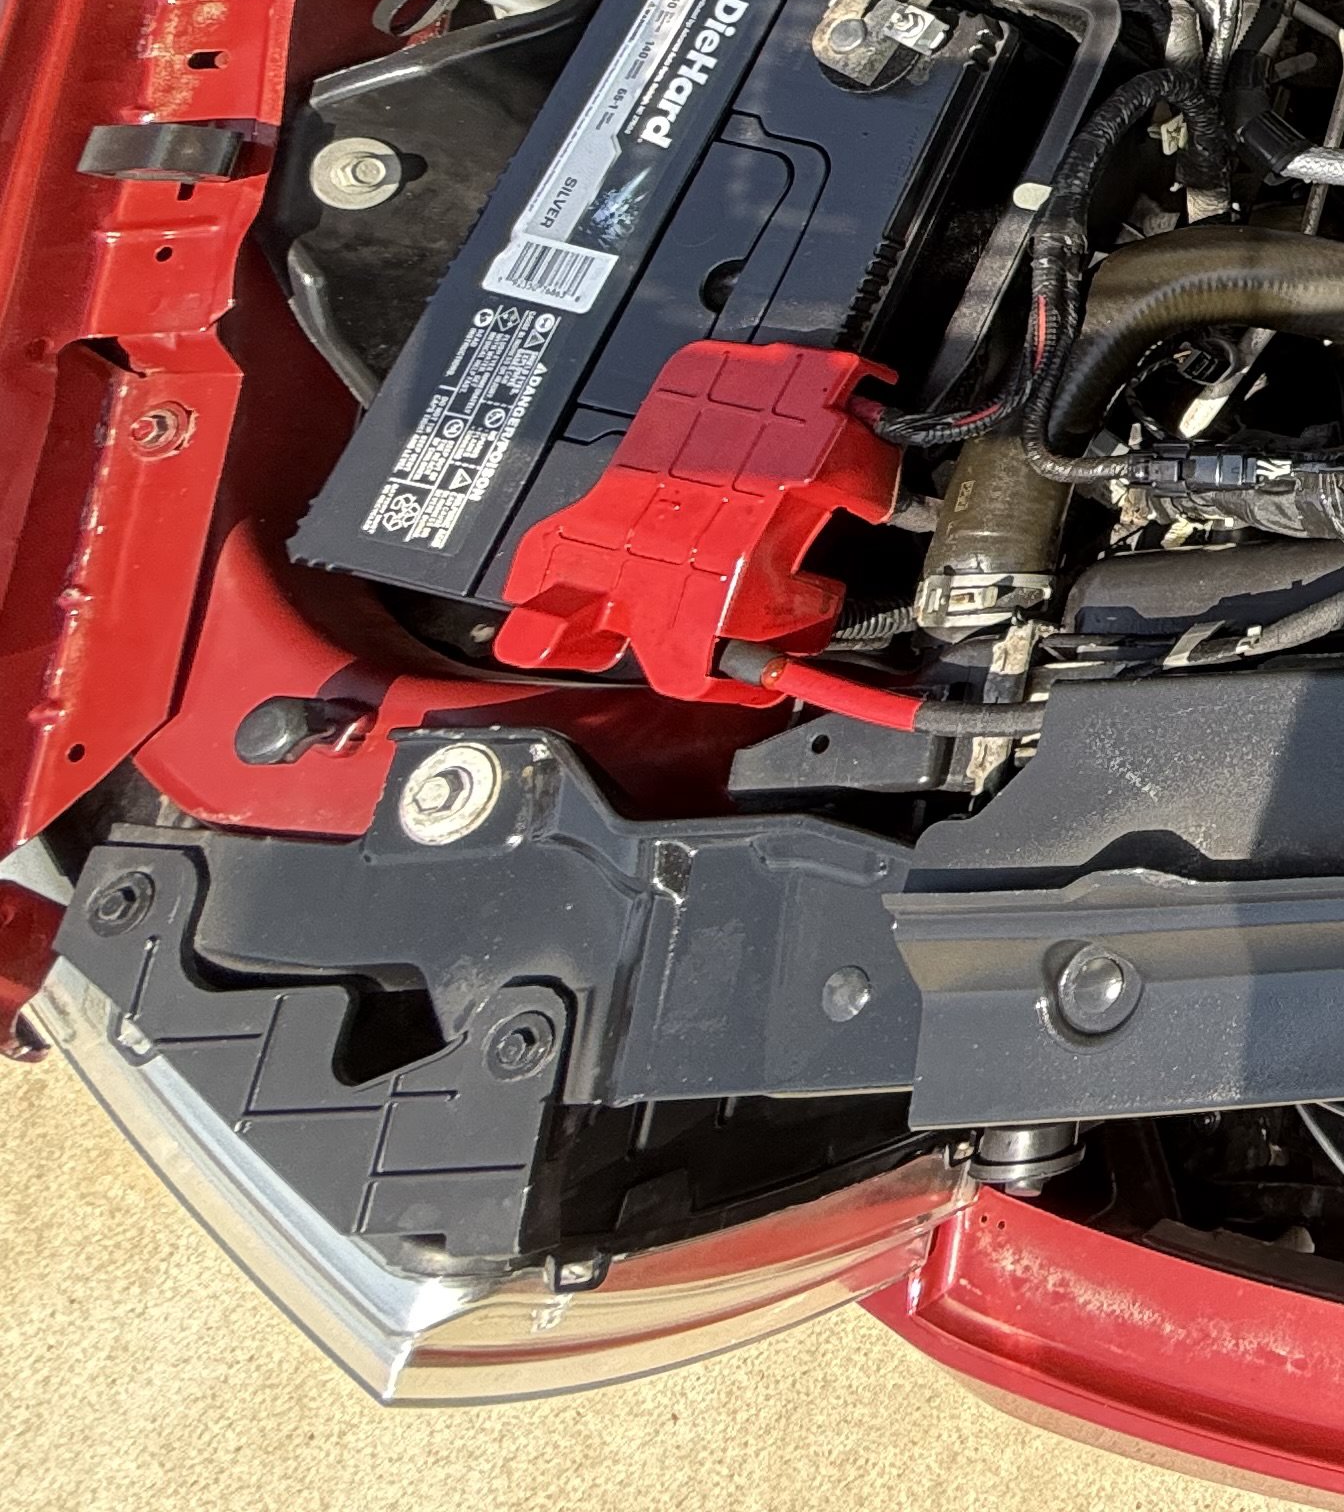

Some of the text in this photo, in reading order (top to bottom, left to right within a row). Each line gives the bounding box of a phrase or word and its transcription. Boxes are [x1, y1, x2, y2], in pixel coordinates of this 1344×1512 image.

[637, 39, 655, 59] 140
[607, 86, 627, 110] 65-1
[539, 175, 578, 229] SILVER
[467, 373, 543, 502] DANGER/POISON
